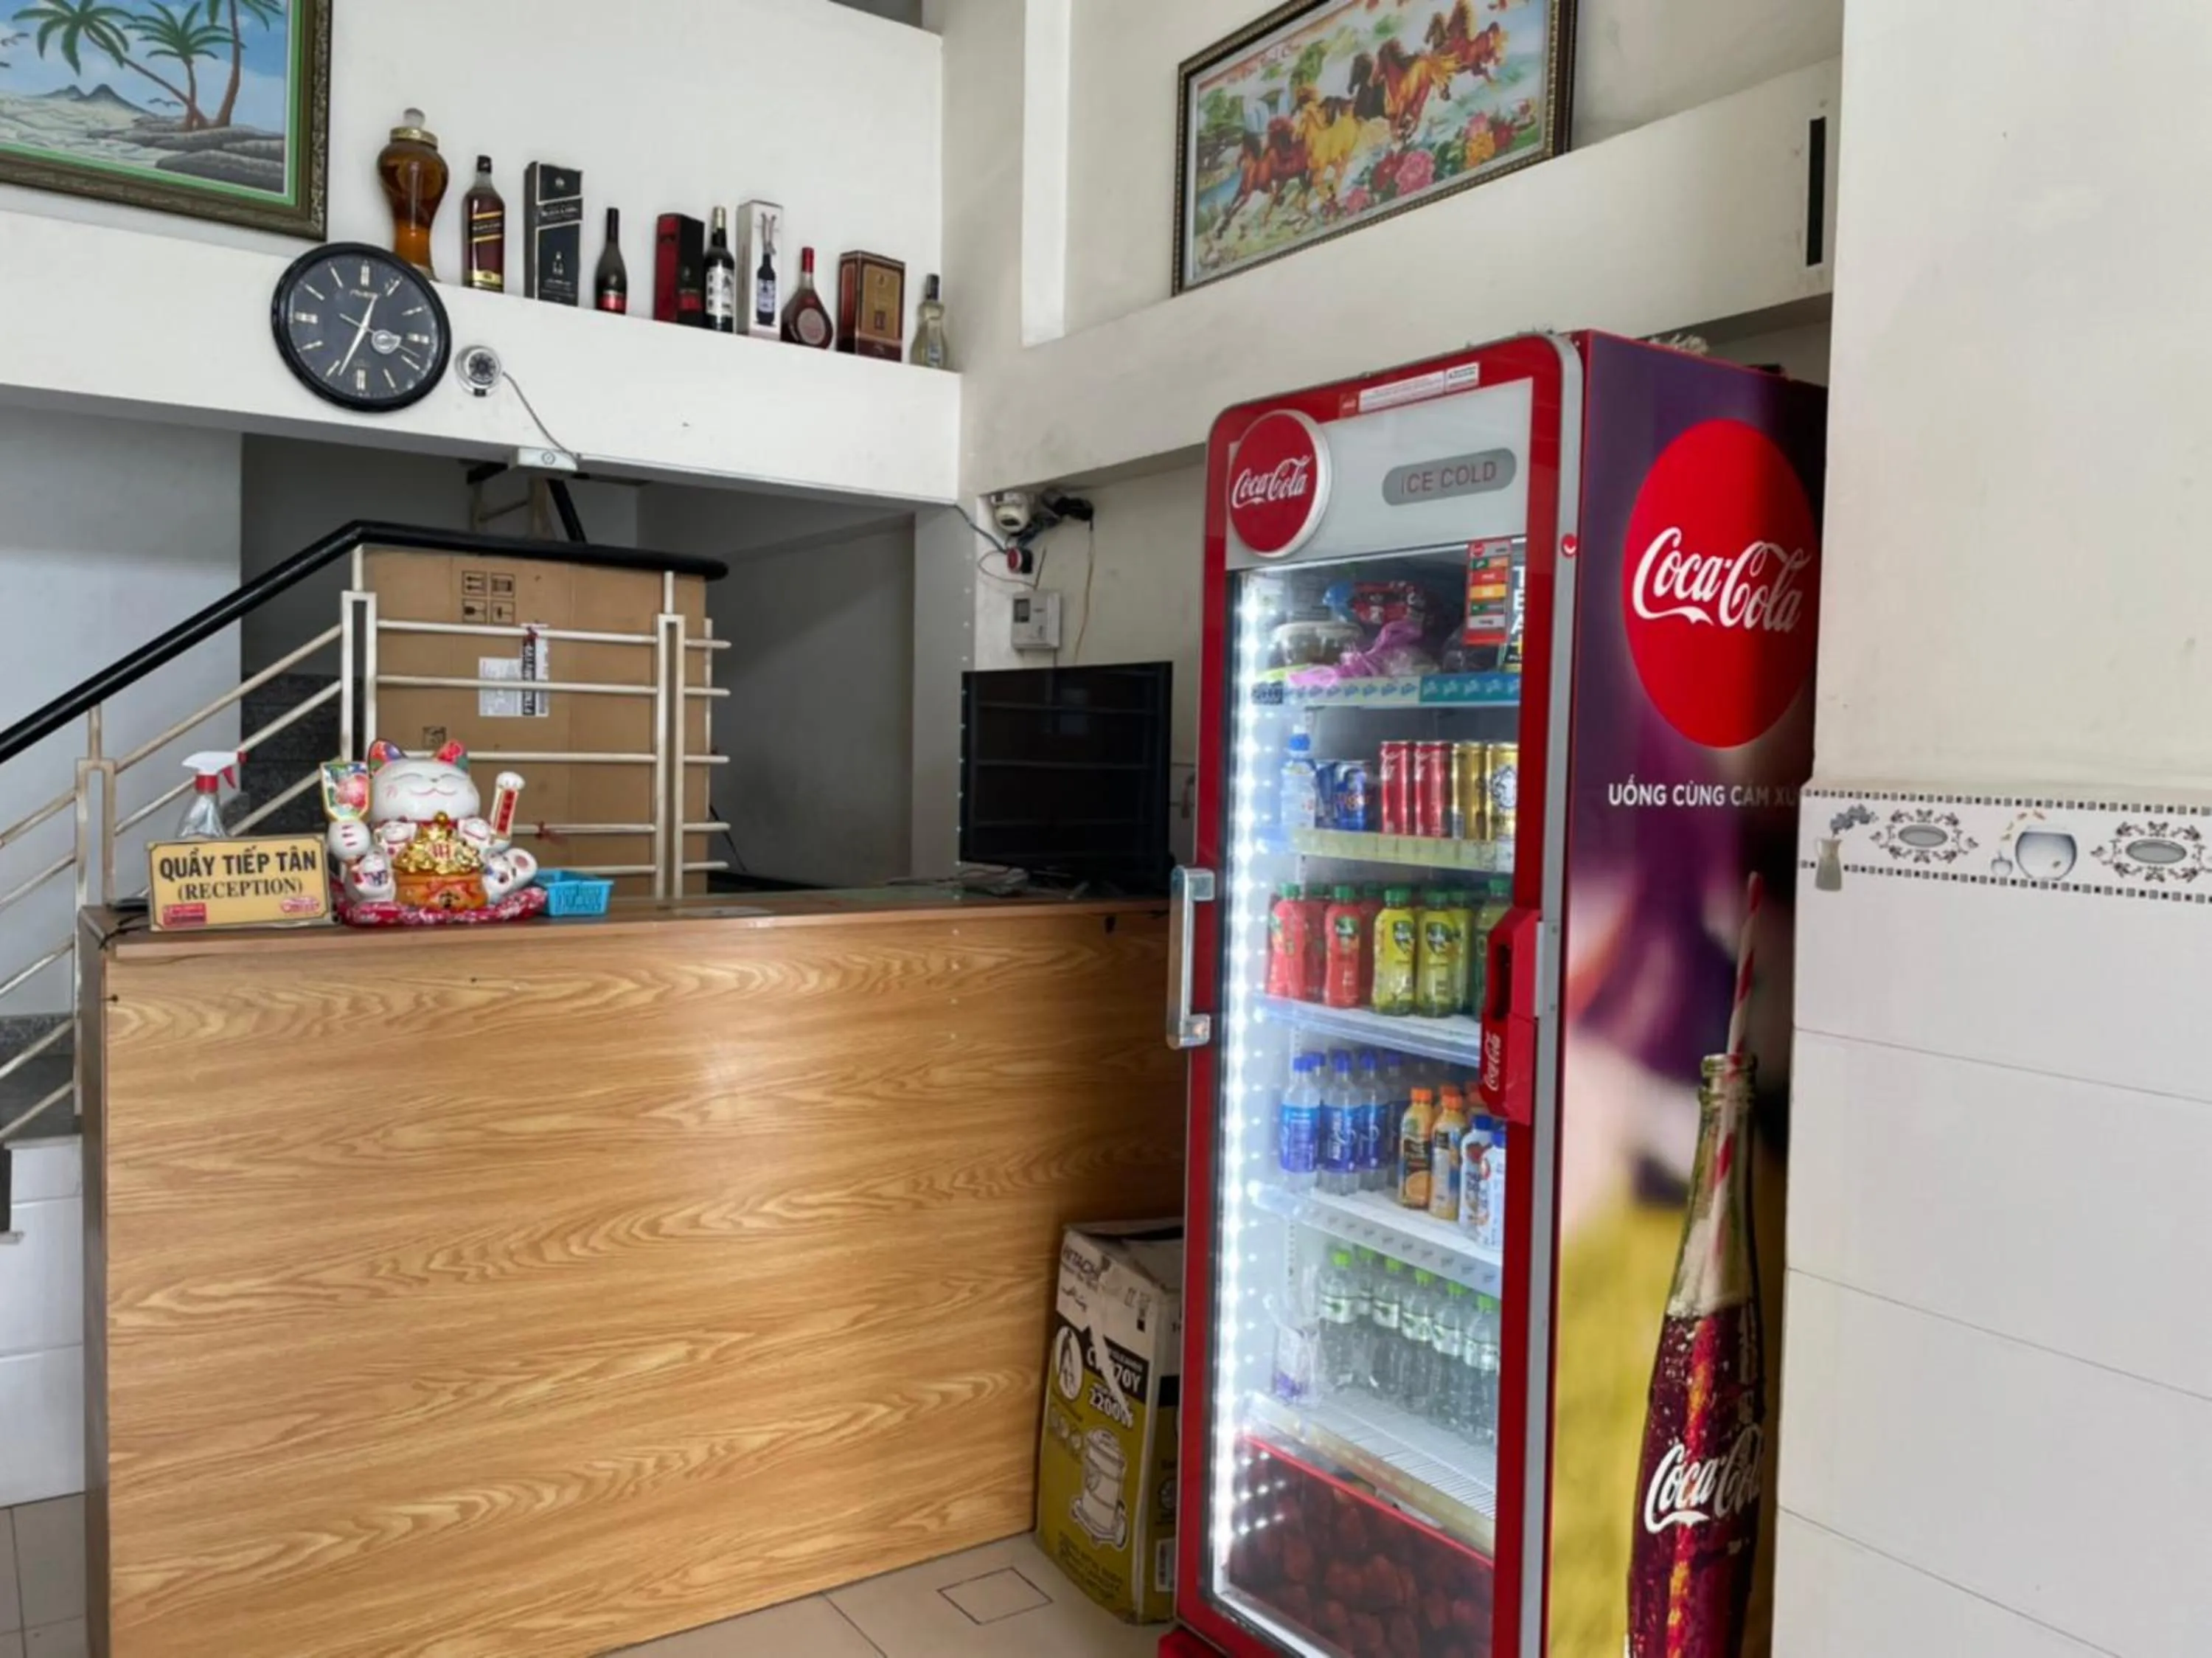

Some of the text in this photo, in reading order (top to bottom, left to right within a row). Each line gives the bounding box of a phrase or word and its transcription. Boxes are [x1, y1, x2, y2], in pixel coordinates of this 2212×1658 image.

[1231, 454, 1312, 509] Coca-Cola
[1401, 460, 1498, 495] ICE COLD
[1632, 527, 1812, 633] Coca-Cola
[1608, 773, 1666, 806] UỐNG
[1672, 780, 1725, 806] CÙNG
[222, 844, 270, 875] TIẾP
[275, 845, 317, 873] TÂN
[177, 878, 303, 901] (RECEPTION)
